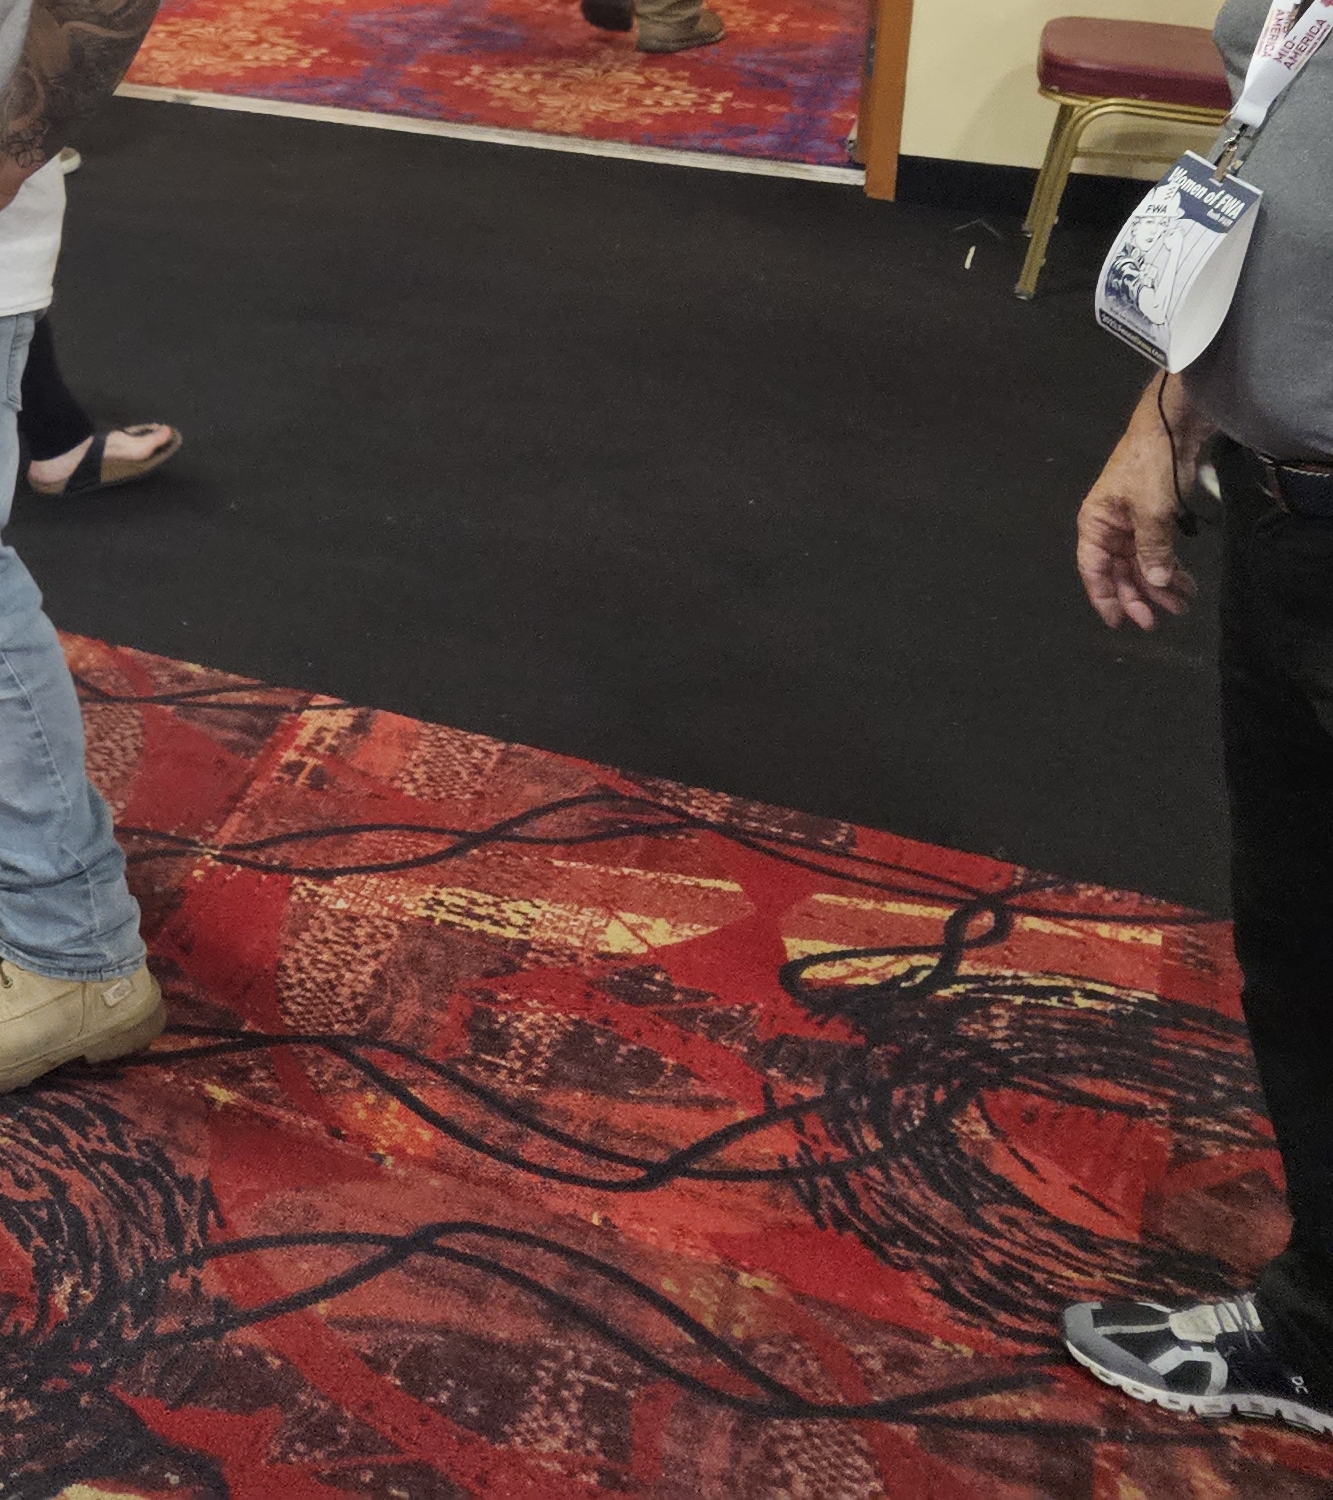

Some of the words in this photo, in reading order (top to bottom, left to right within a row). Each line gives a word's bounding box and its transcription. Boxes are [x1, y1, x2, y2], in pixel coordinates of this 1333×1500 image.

[1274, 36, 1297, 63] MID-
[1284, 19, 1328, 70] AMERICA
[1145, 204, 1167, 214] FWA
[1168, 166, 1208, 200] Women
[1203, 189, 1225, 206] of
[1214, 193, 1245, 220] FWA
